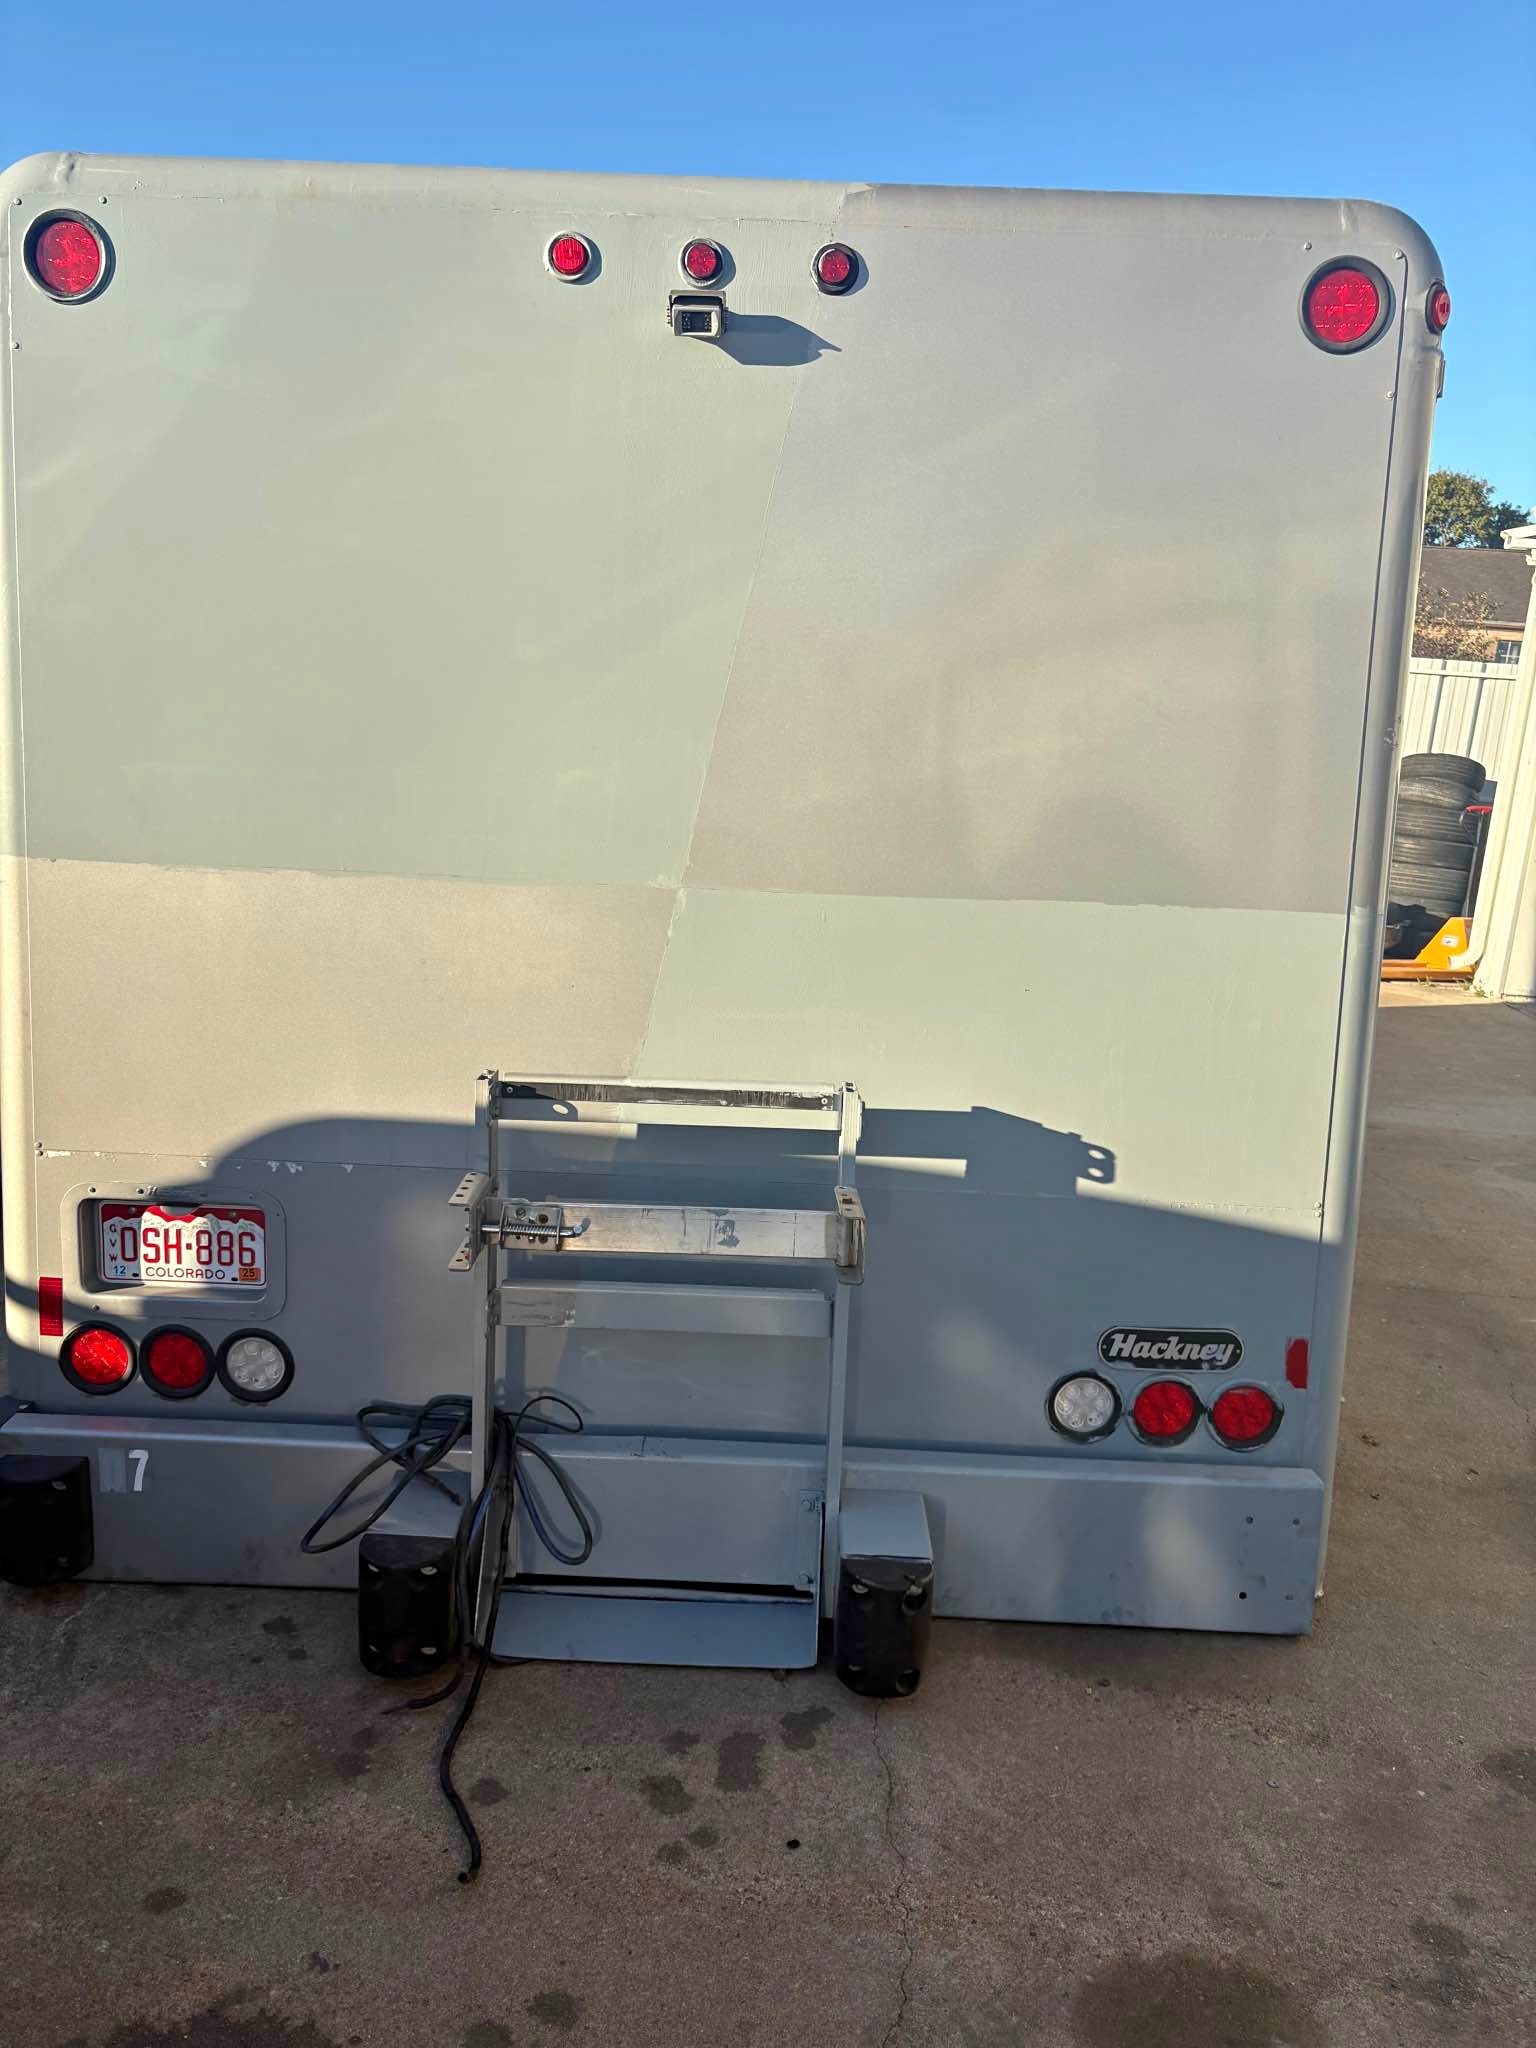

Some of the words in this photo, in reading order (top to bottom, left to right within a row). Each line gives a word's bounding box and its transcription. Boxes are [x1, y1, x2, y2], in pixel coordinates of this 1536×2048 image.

[113, 1265, 127, 1275] 12
[145, 1267, 226, 1280] COLORADO
[242, 1267, 256, 1278] 25
[1108, 1333, 1235, 1366] Hackney
[128, 1449, 149, 1491] 7
